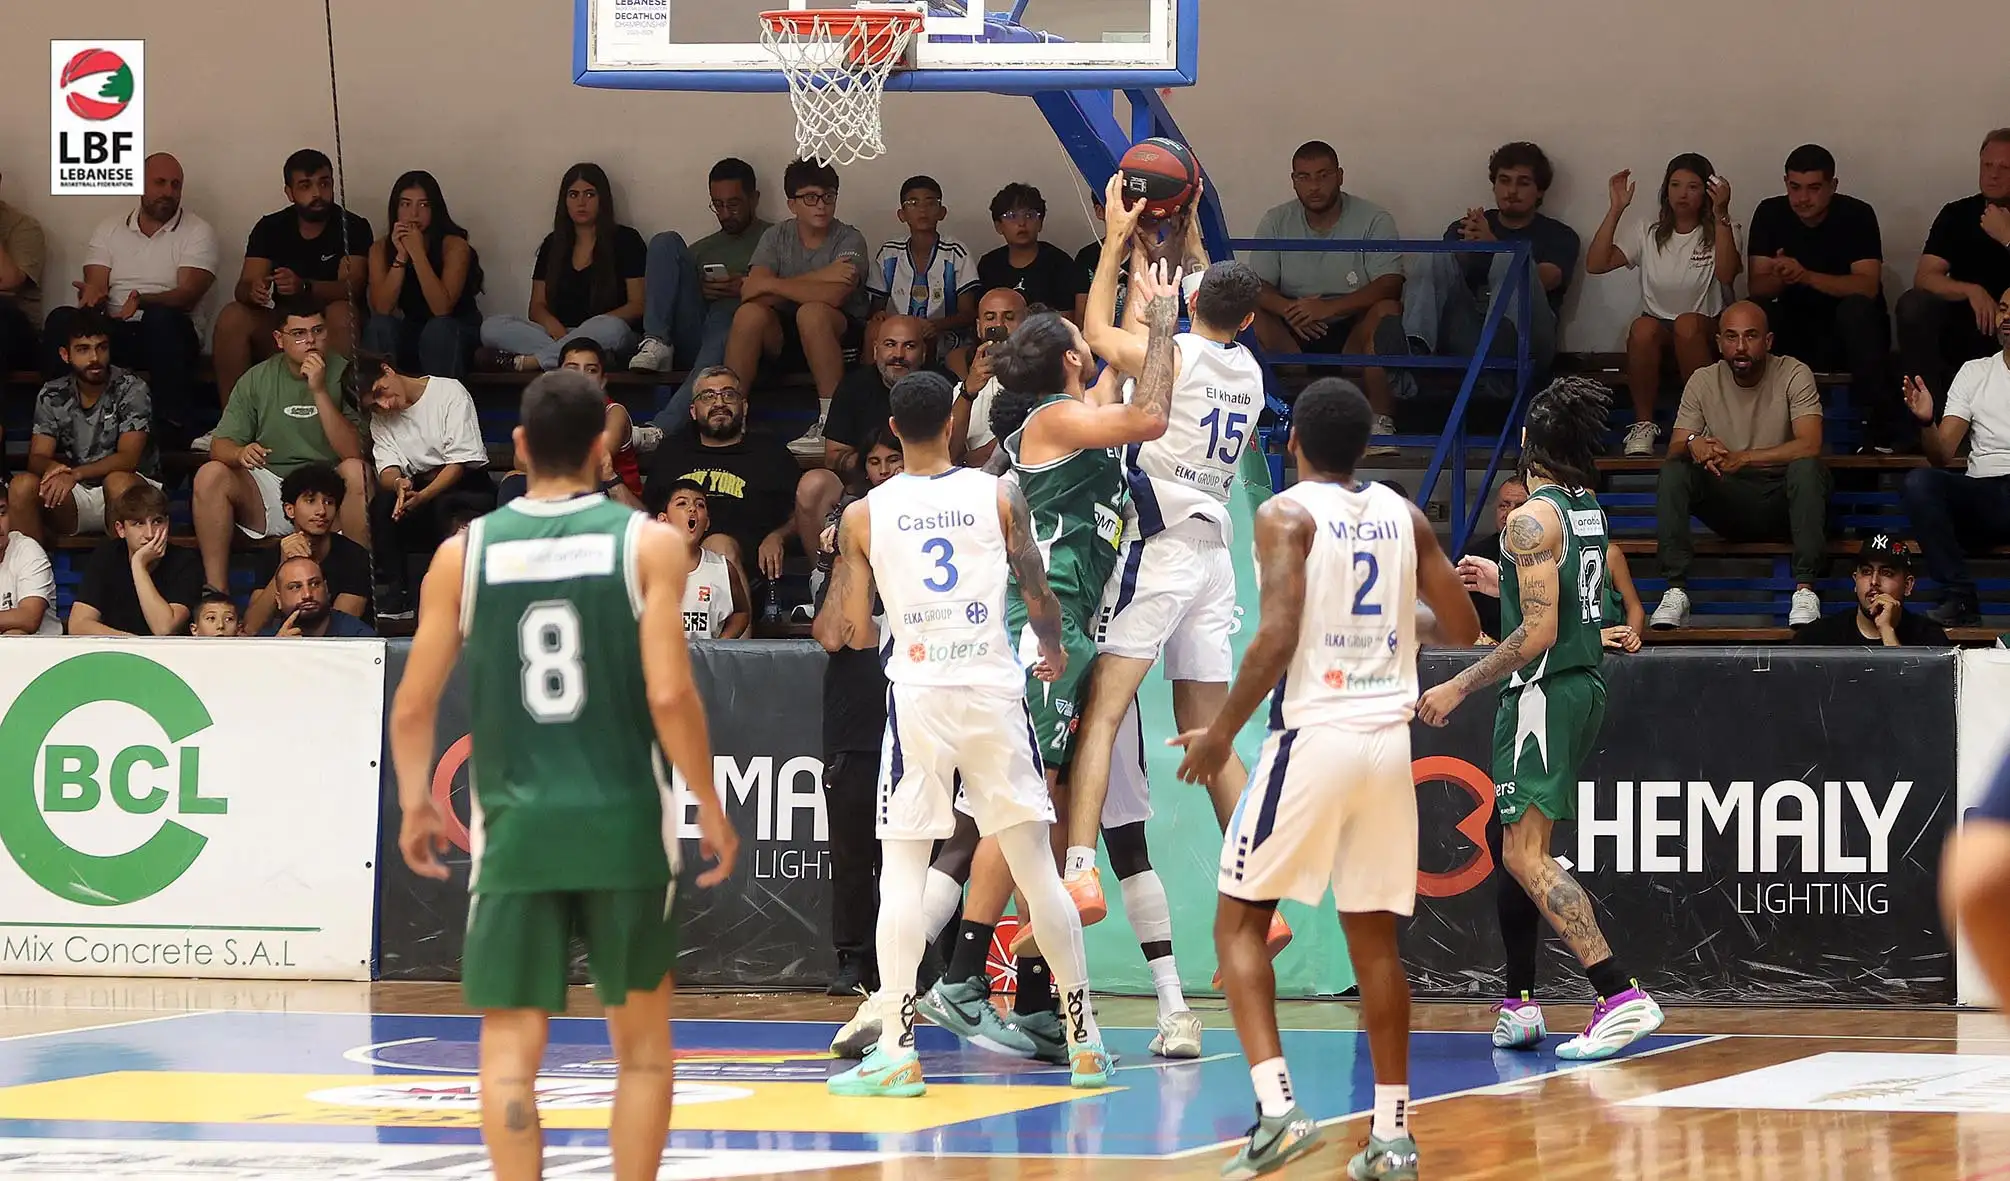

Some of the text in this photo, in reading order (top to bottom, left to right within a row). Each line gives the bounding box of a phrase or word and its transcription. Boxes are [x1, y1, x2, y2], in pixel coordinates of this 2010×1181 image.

[615, 12, 667, 20] DECATHLON
[1205, 386, 1251, 405] El khatib
[1199, 407, 1248, 465] 15
[1174, 465, 1220, 488] ELKA GROUP
[897, 510, 975, 531] Castillo
[1871, 533, 1889, 550] NY
[921, 537, 959, 593] 3
[1350, 551, 1382, 615] 2
[903, 609, 952, 625] ELKA GROUP
[928, 640, 989, 662] toters
[1325, 633, 1373, 649] ELKA GROUP
[518, 598, 589, 724] 8
[43, 744, 228, 815] BCL
[1553, 780, 1914, 873] HEMALY
[755, 849, 833, 880] LIGHT
[1736, 882, 1889, 914] LIGHTING
[3, 934, 296, 967] Mix Concrete S.A.L
